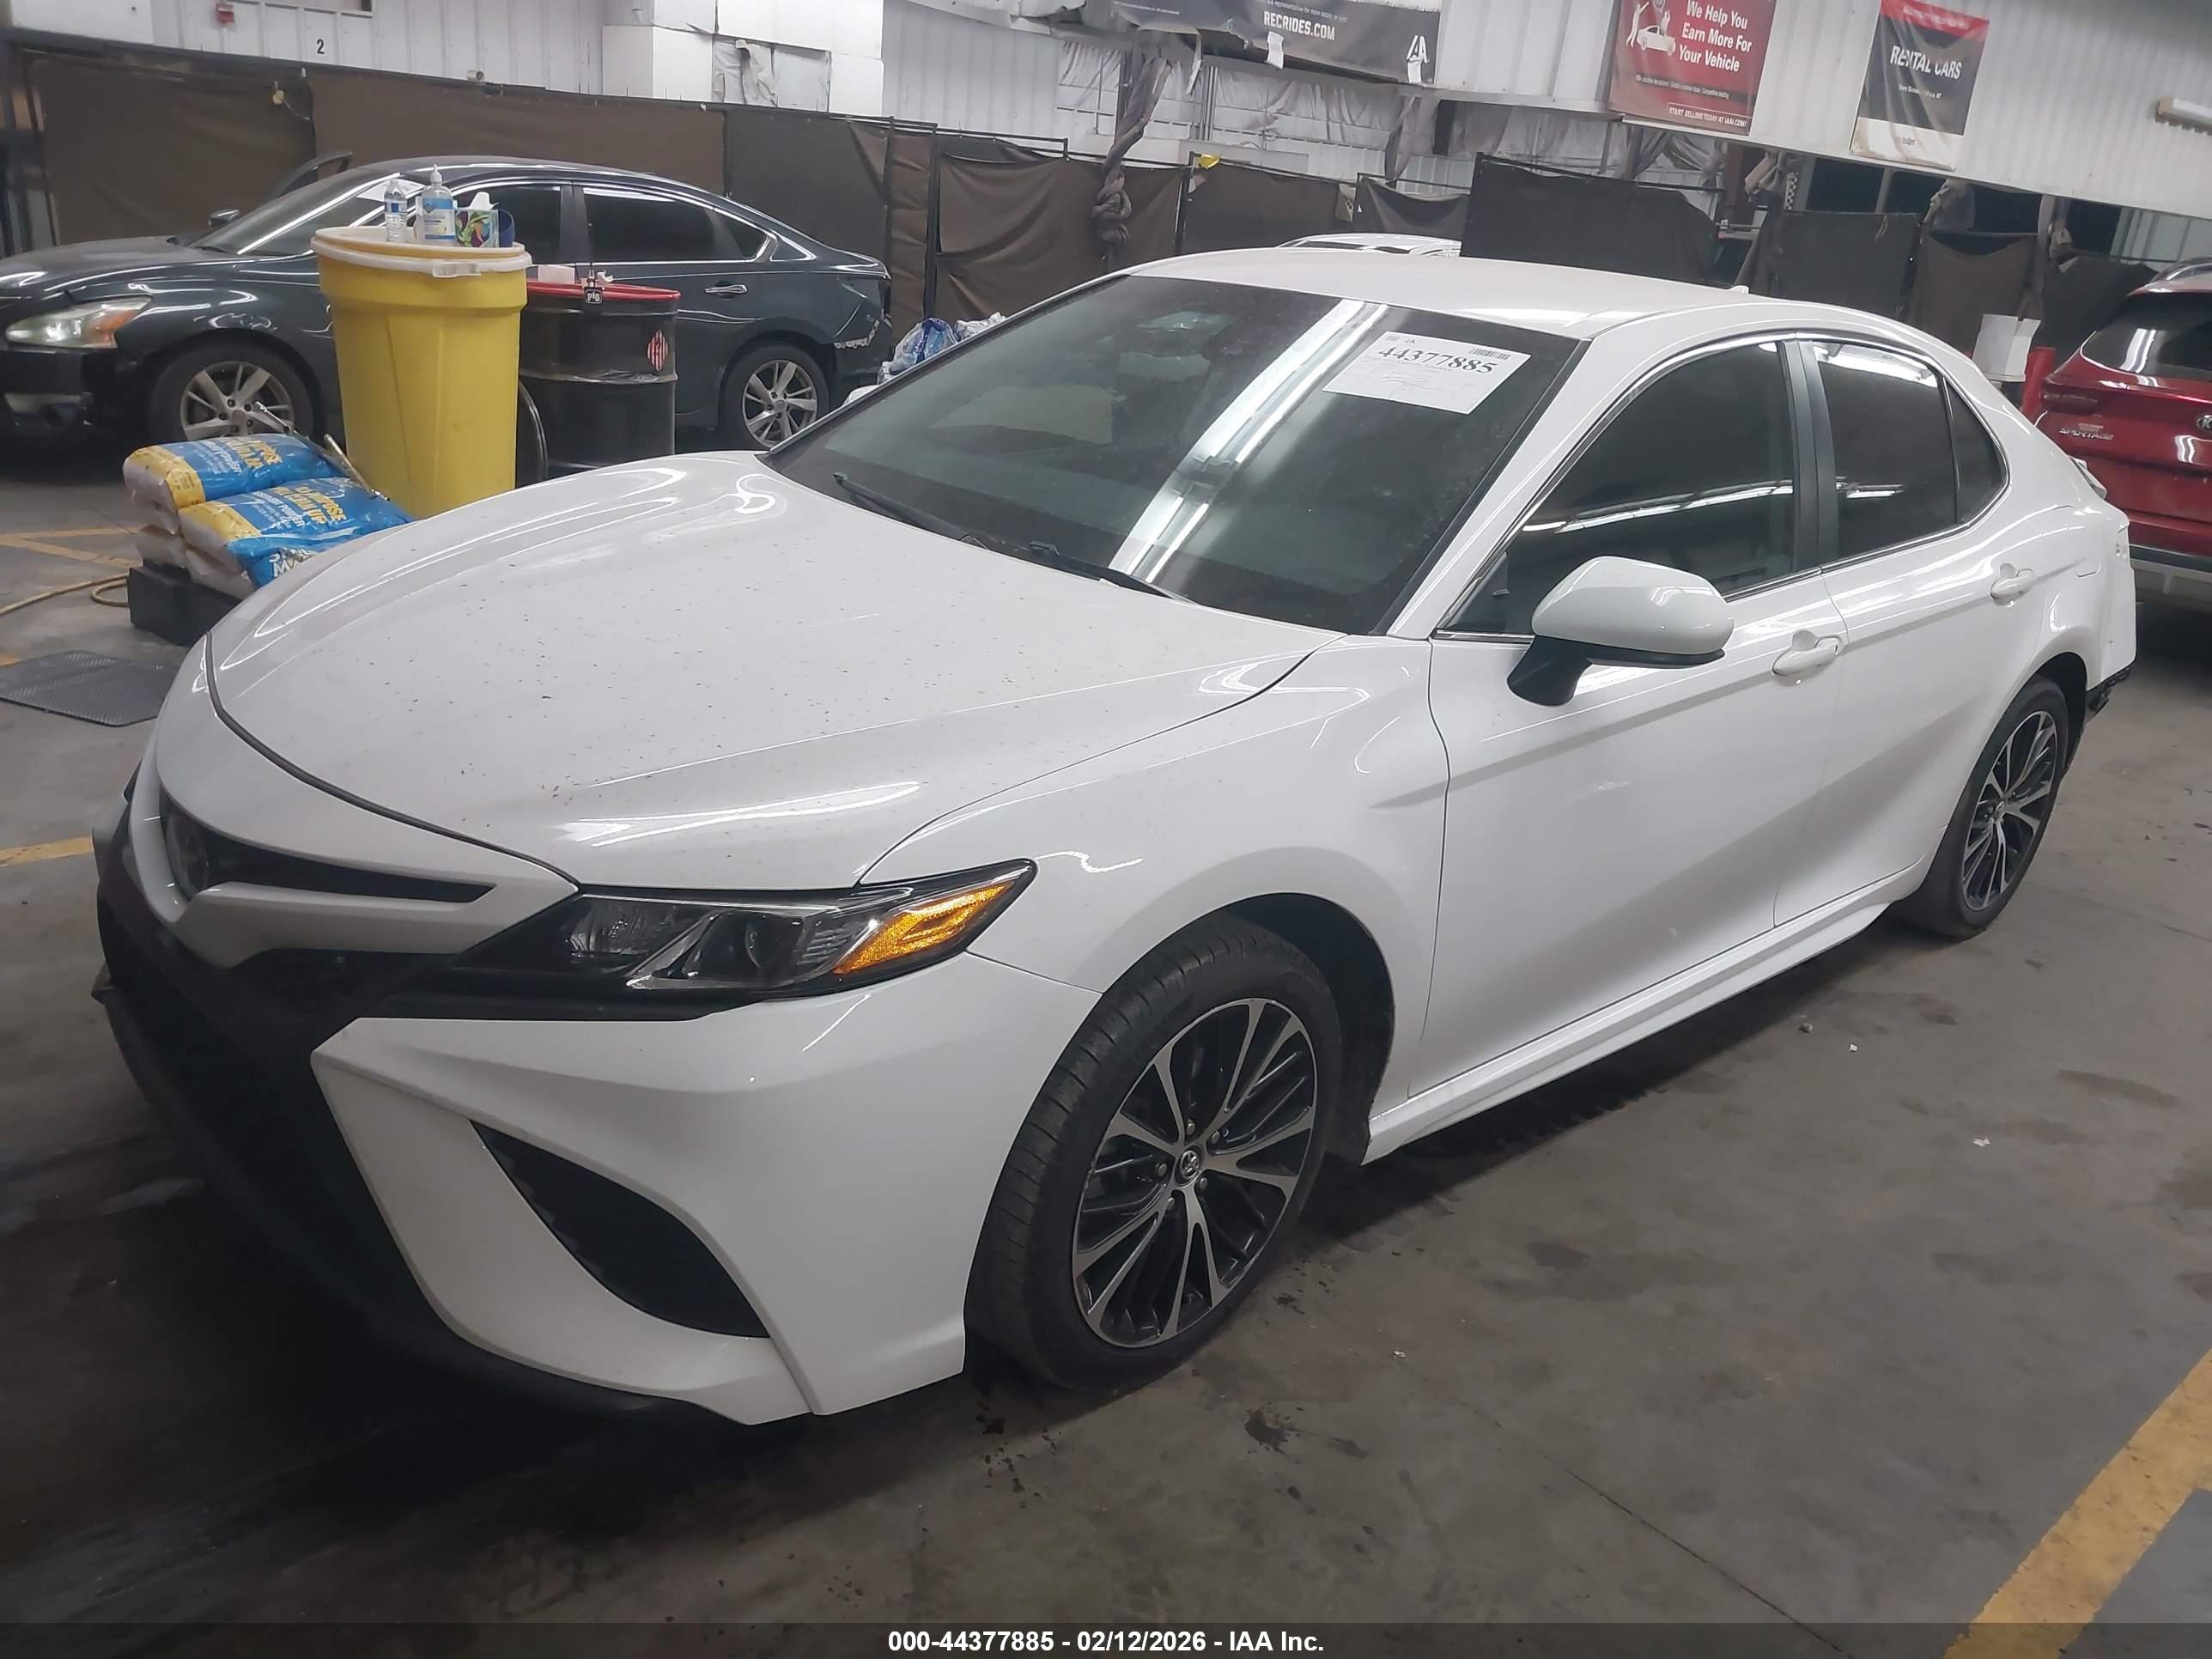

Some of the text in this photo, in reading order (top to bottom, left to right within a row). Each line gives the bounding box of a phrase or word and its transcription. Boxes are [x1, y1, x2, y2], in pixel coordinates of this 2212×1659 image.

[1263, 10, 1335, 41] RECRIDES.COM
[1686, 0, 1748, 30] We Help You
[317, 39, 325, 54] 2
[1681, 22, 1753, 52] Earn More For
[1679, 44, 1740, 72] Your Vehicle
[1889, 46, 1962, 80] RENTAL CARS
[1378, 347, 1498, 374] 44377885
